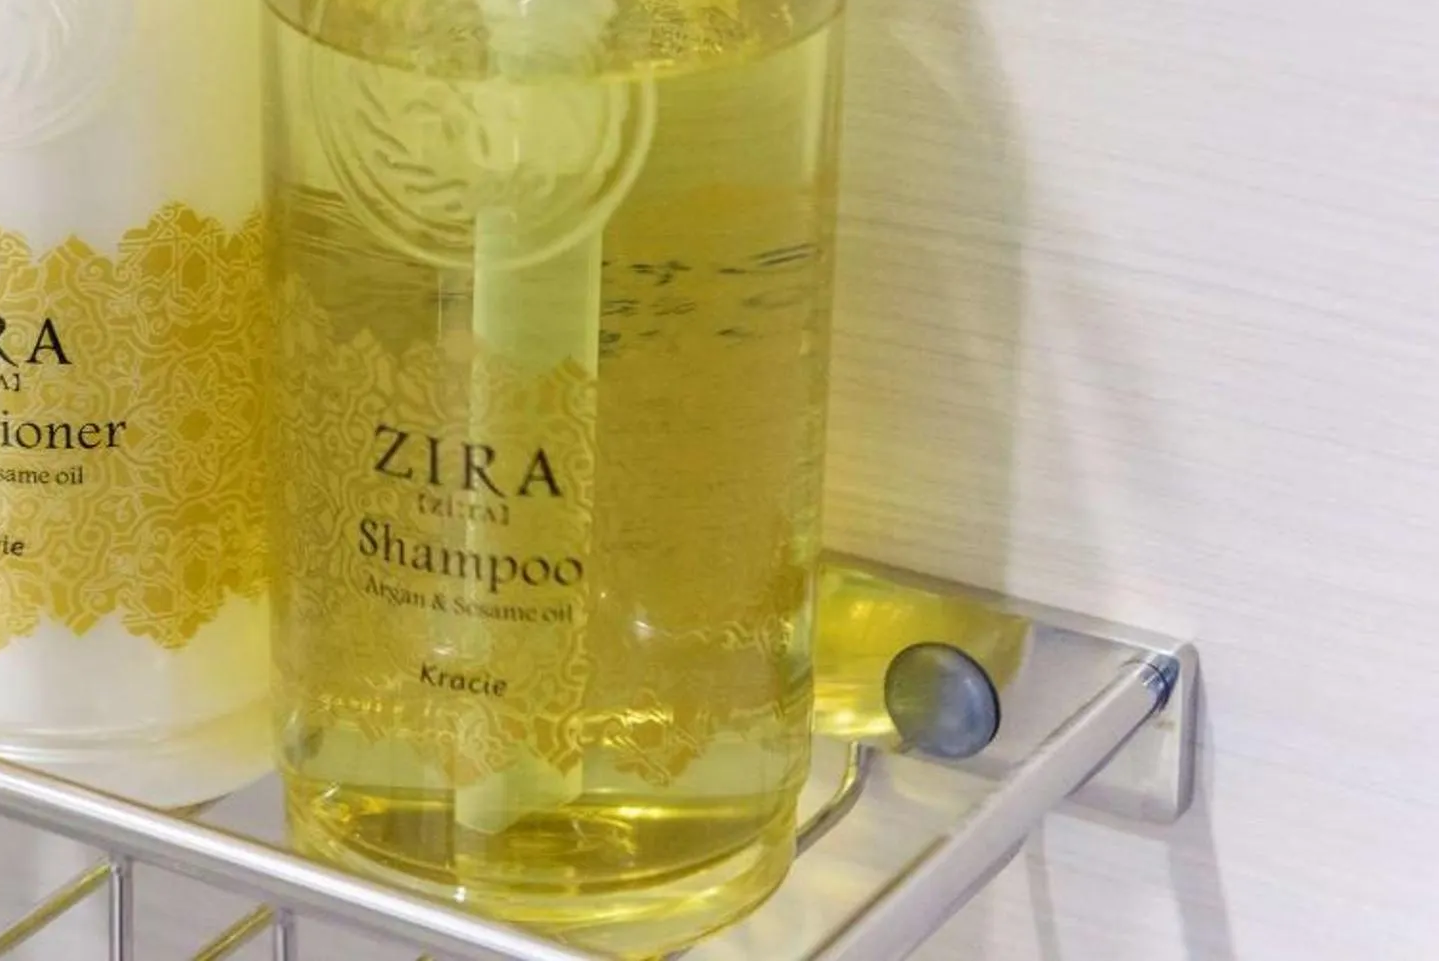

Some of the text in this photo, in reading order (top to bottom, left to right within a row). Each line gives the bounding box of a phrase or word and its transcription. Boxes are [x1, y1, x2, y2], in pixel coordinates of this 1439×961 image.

[55, 466, 84, 486] oil
[373, 424, 564, 498] ZIRA
[359, 518, 583, 594] Shampoo
[364, 575, 573, 625] Argan & Sesame oil
[419, 662, 508, 697] Kracie
